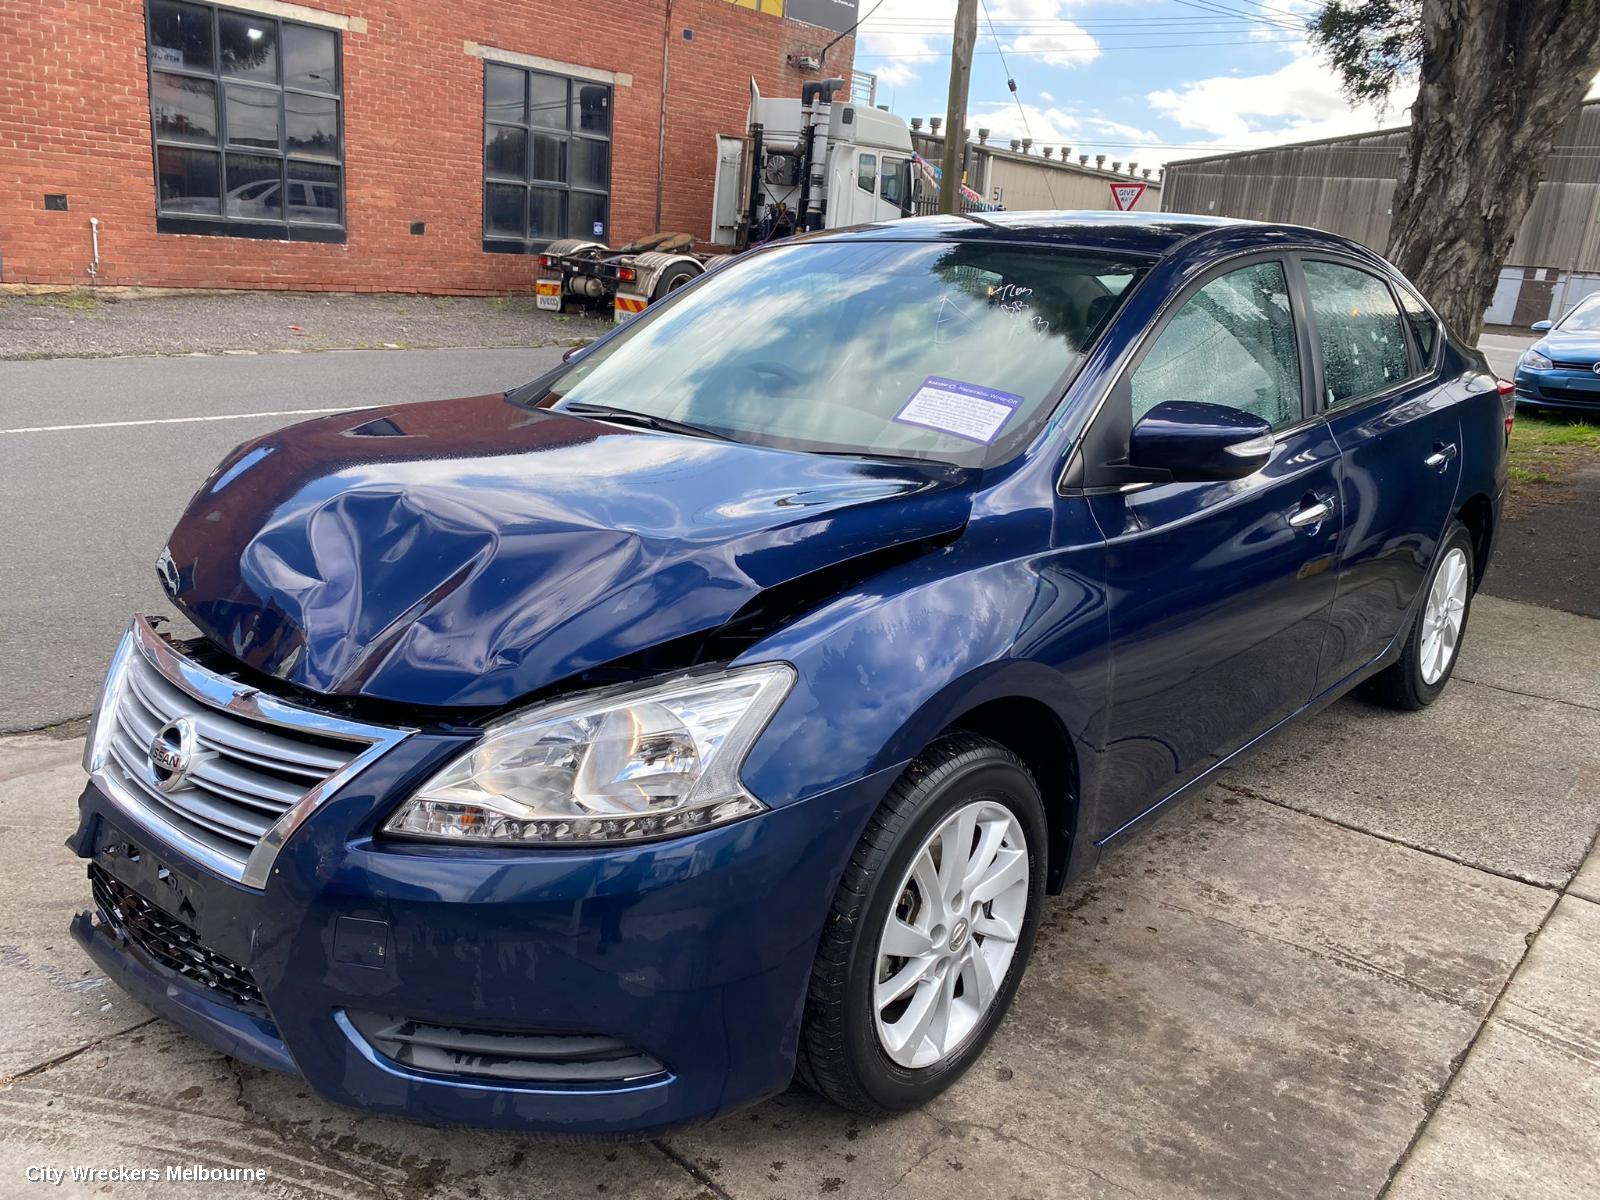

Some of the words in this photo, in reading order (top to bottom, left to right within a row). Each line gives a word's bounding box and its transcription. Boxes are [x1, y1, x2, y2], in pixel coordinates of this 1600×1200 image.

[993, 186, 1003, 202] 51
[540, 296, 559, 306] IVECO
[151, 746, 180, 768] SSAN
